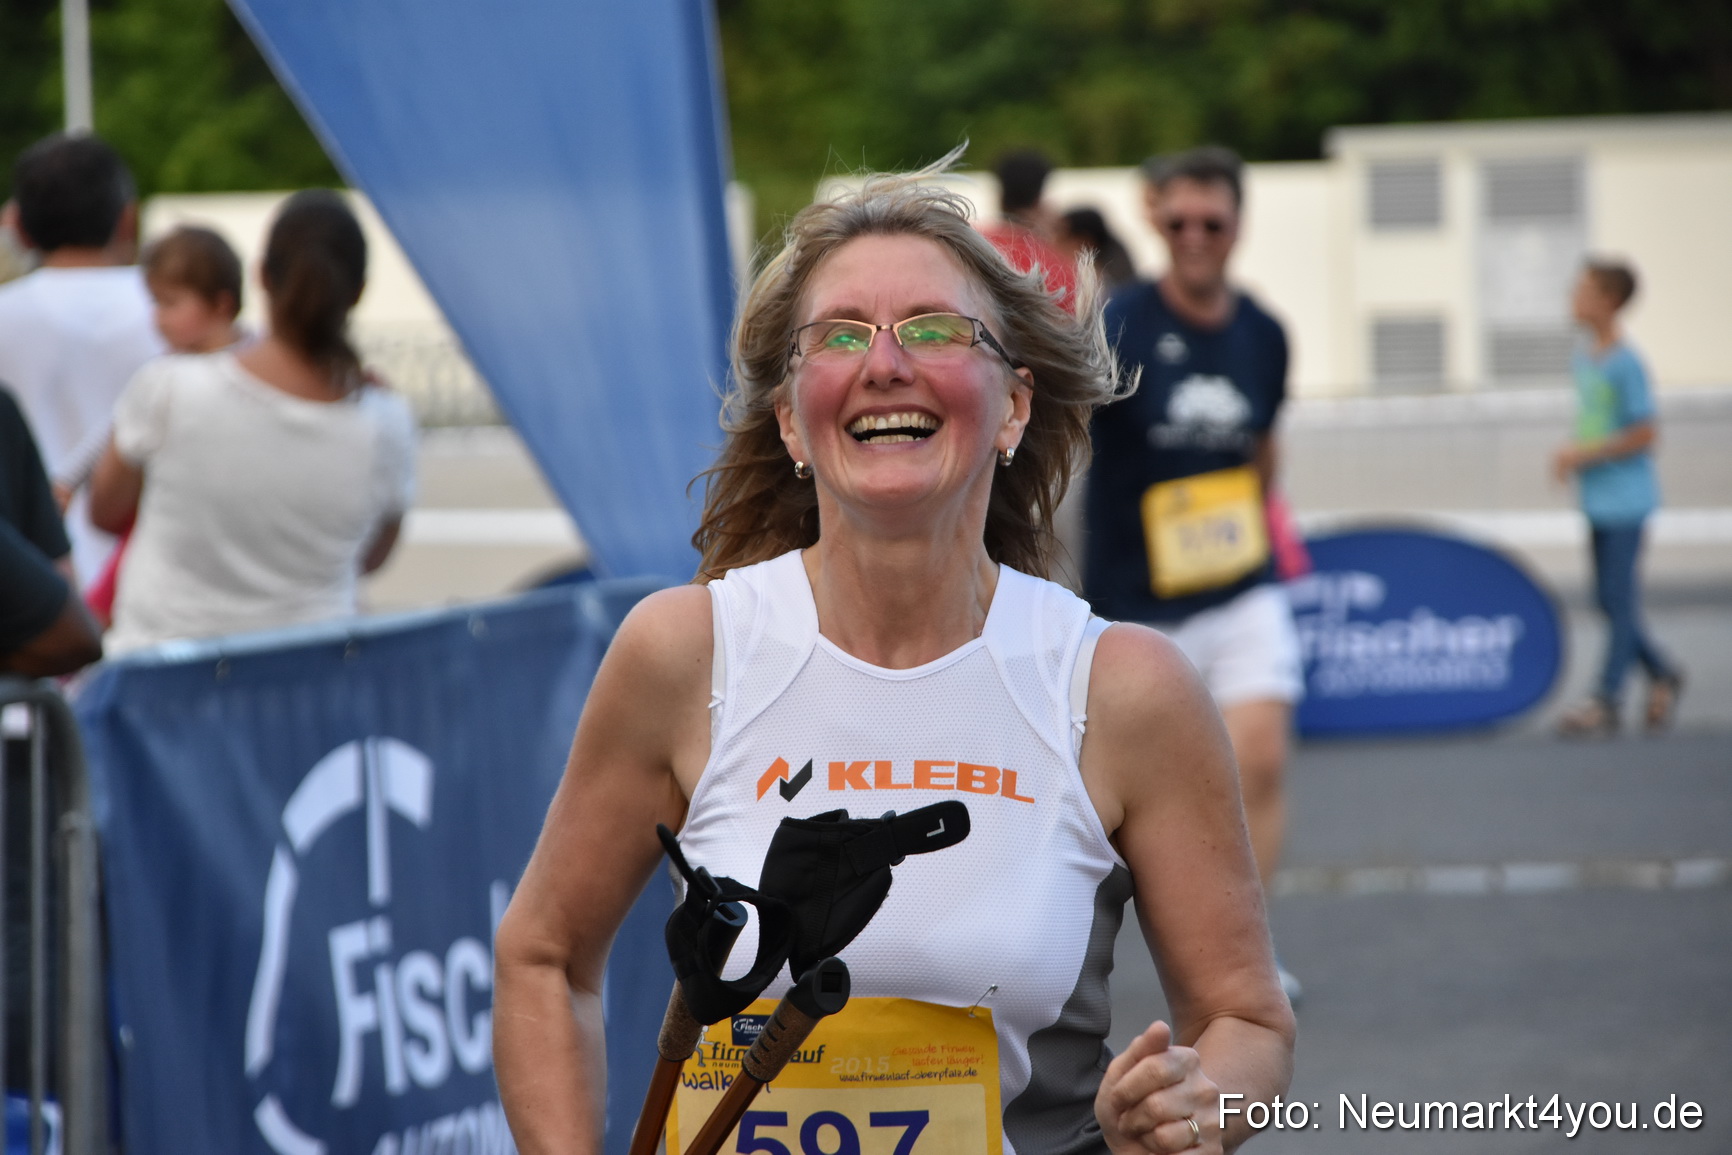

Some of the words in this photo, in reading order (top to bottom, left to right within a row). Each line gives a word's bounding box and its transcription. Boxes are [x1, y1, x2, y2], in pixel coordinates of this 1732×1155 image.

[828, 760, 1035, 804] KLEBL
[830, 1056, 890, 1074] 2015
[736, 1110, 929, 1155] 597
